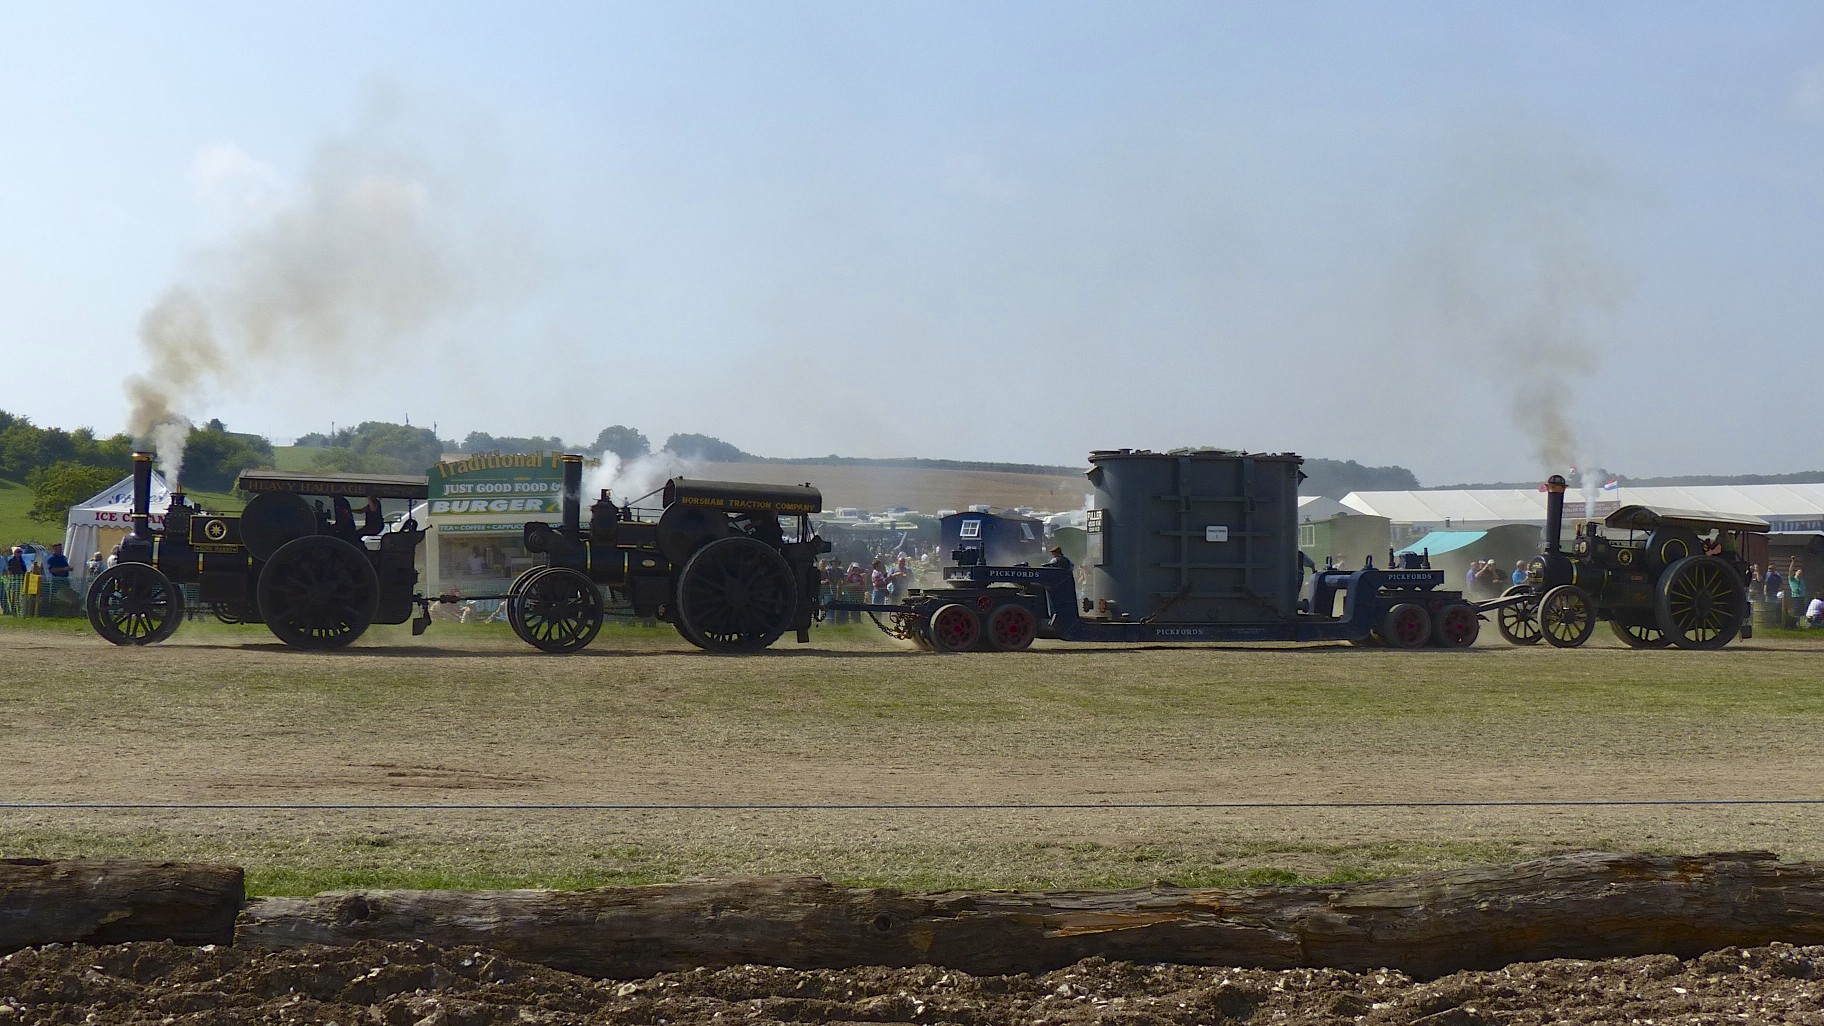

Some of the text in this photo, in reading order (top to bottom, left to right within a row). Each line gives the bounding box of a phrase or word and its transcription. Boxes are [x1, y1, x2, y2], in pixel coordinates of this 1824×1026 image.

[434, 450, 543, 478] Traditional
[250, 480, 298, 491] HEAVY
[301, 484, 366, 494] HAULAGE
[443, 483, 474, 496] JUST
[476, 483, 512, 493] GOOD
[514, 482, 548, 492] FOOD
[431, 499, 544, 514] BURGER
[682, 496, 816, 511] HORSHAM TRACTION COMPANY
[95, 512, 118, 522] ICE
